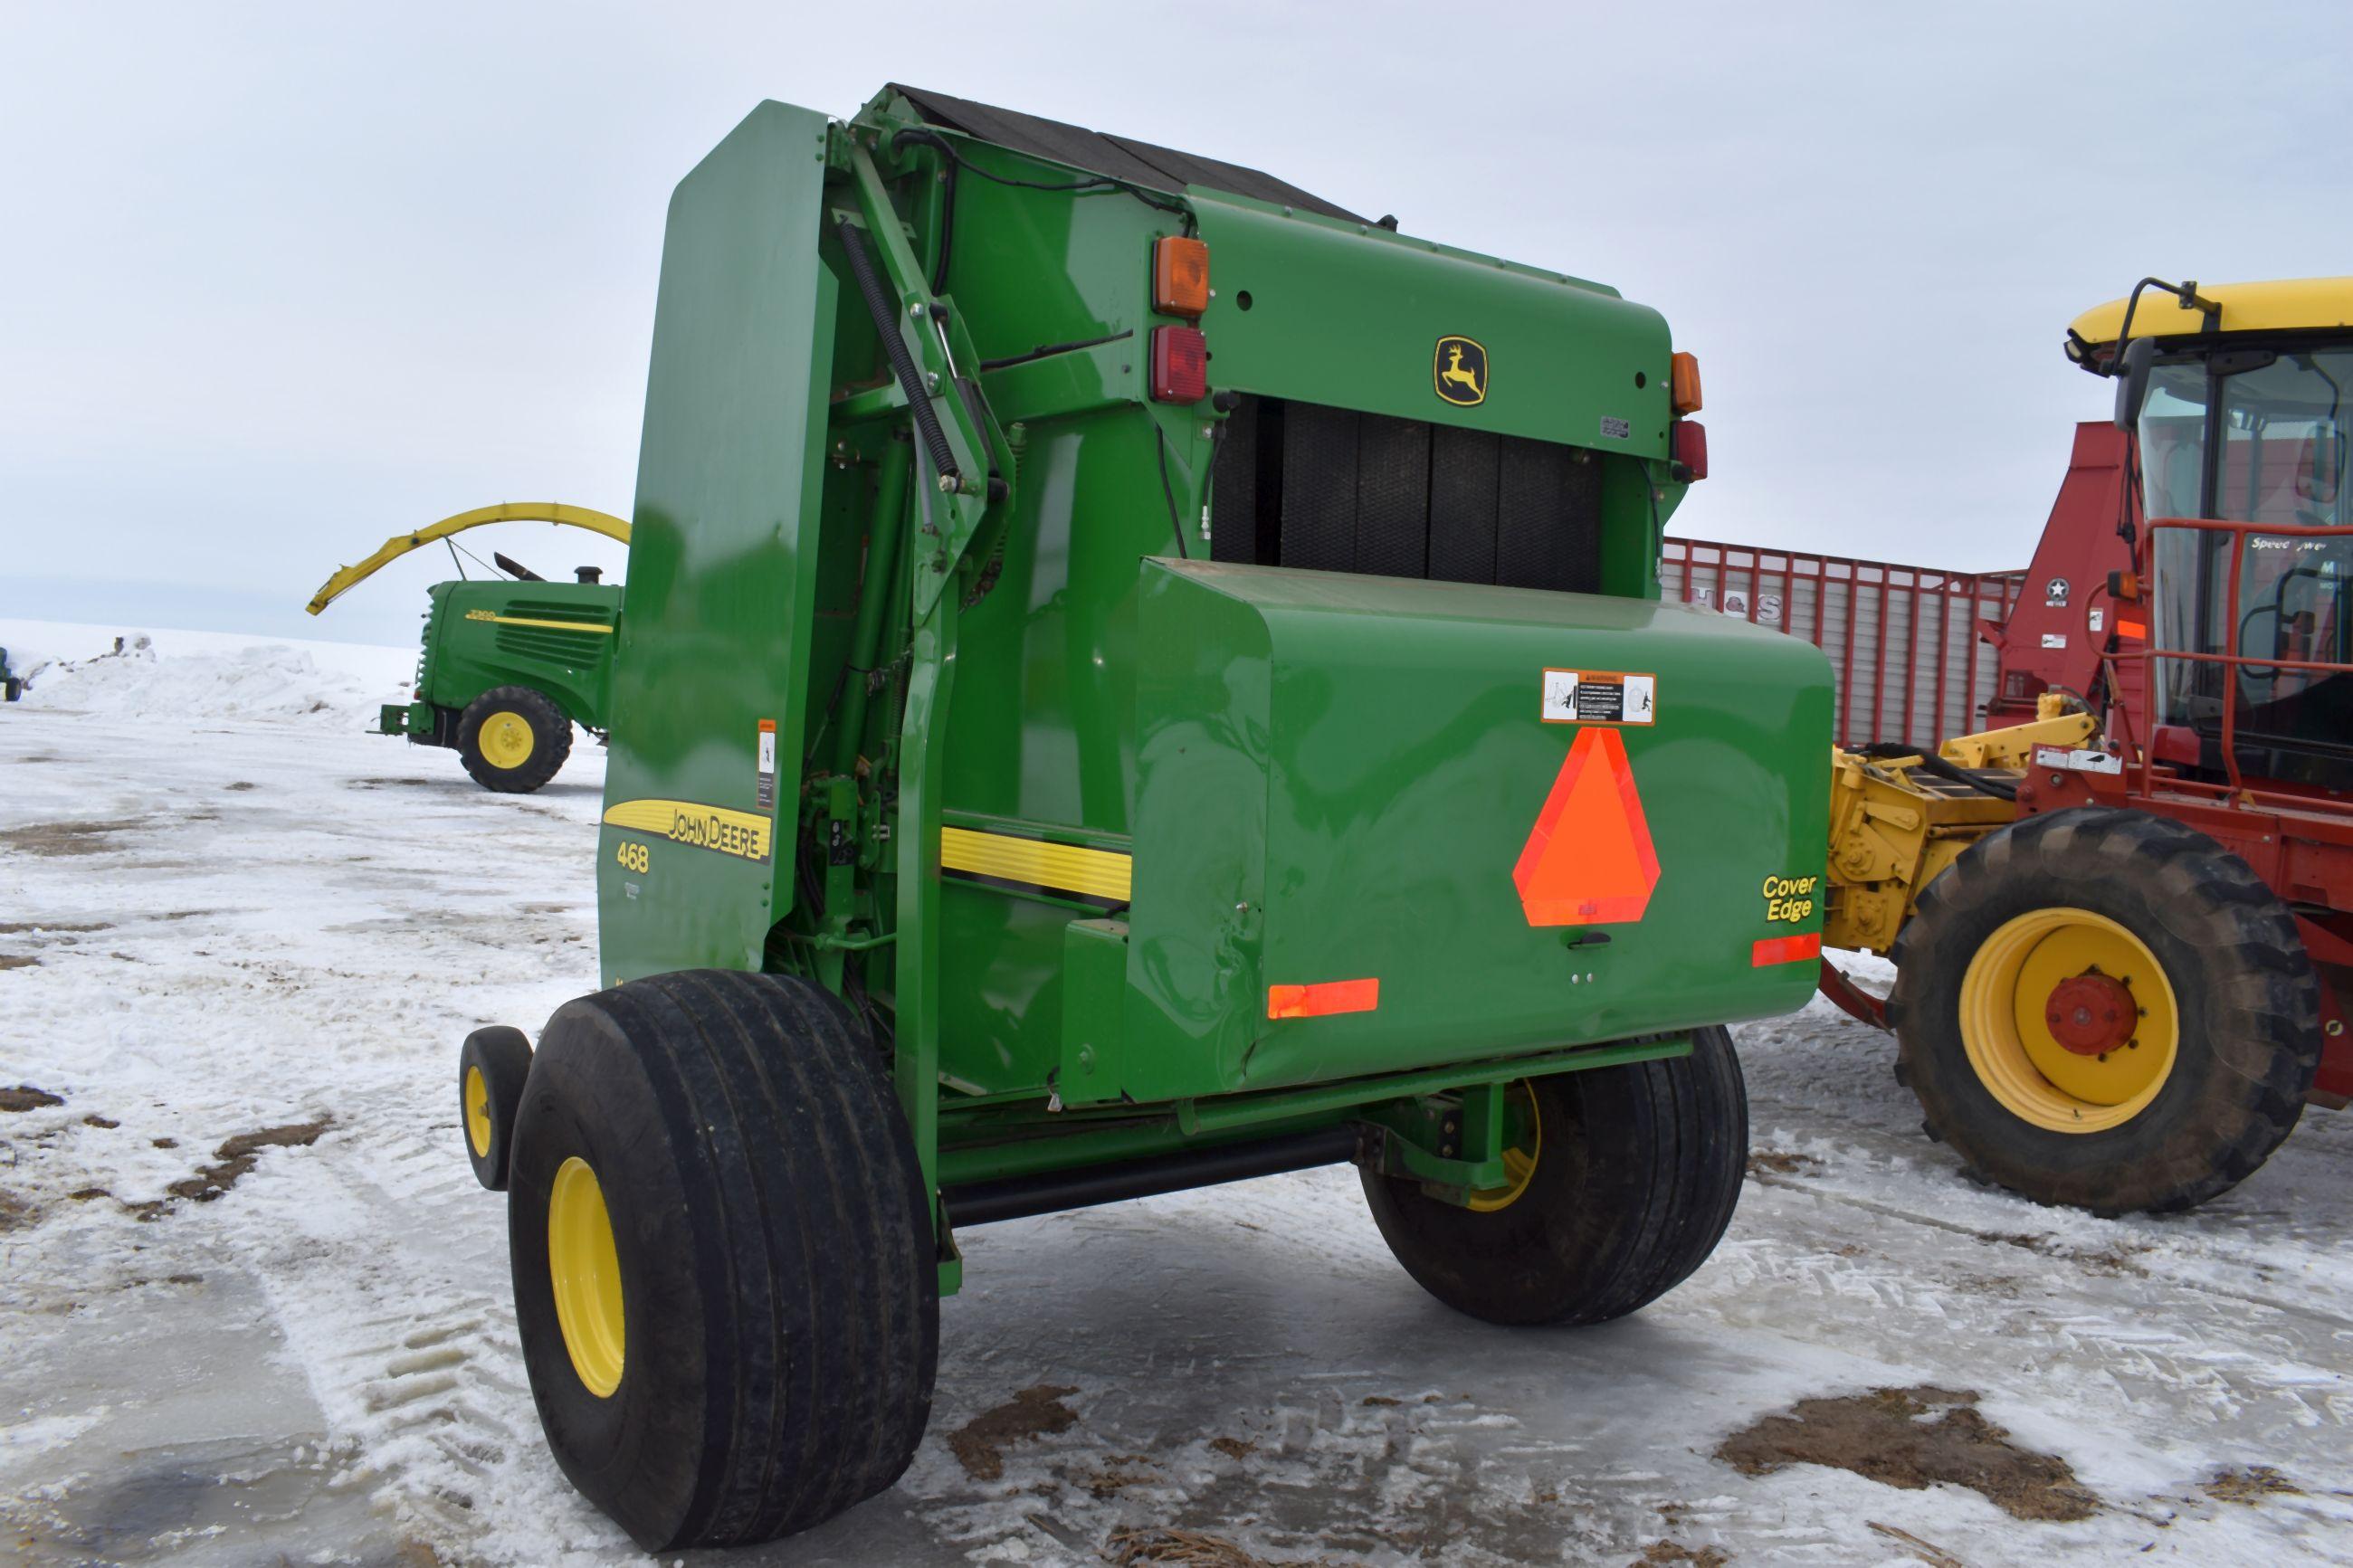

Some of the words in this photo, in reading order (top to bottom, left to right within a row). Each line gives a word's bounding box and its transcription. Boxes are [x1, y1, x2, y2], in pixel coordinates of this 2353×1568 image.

[1758, 594, 1783, 621] S
[668, 808, 709, 846] JOHN
[709, 814, 760, 858] DEERE
[617, 841, 650, 874] 468
[1763, 875, 1817, 898] Cover
[1766, 897, 1812, 923] Edge
